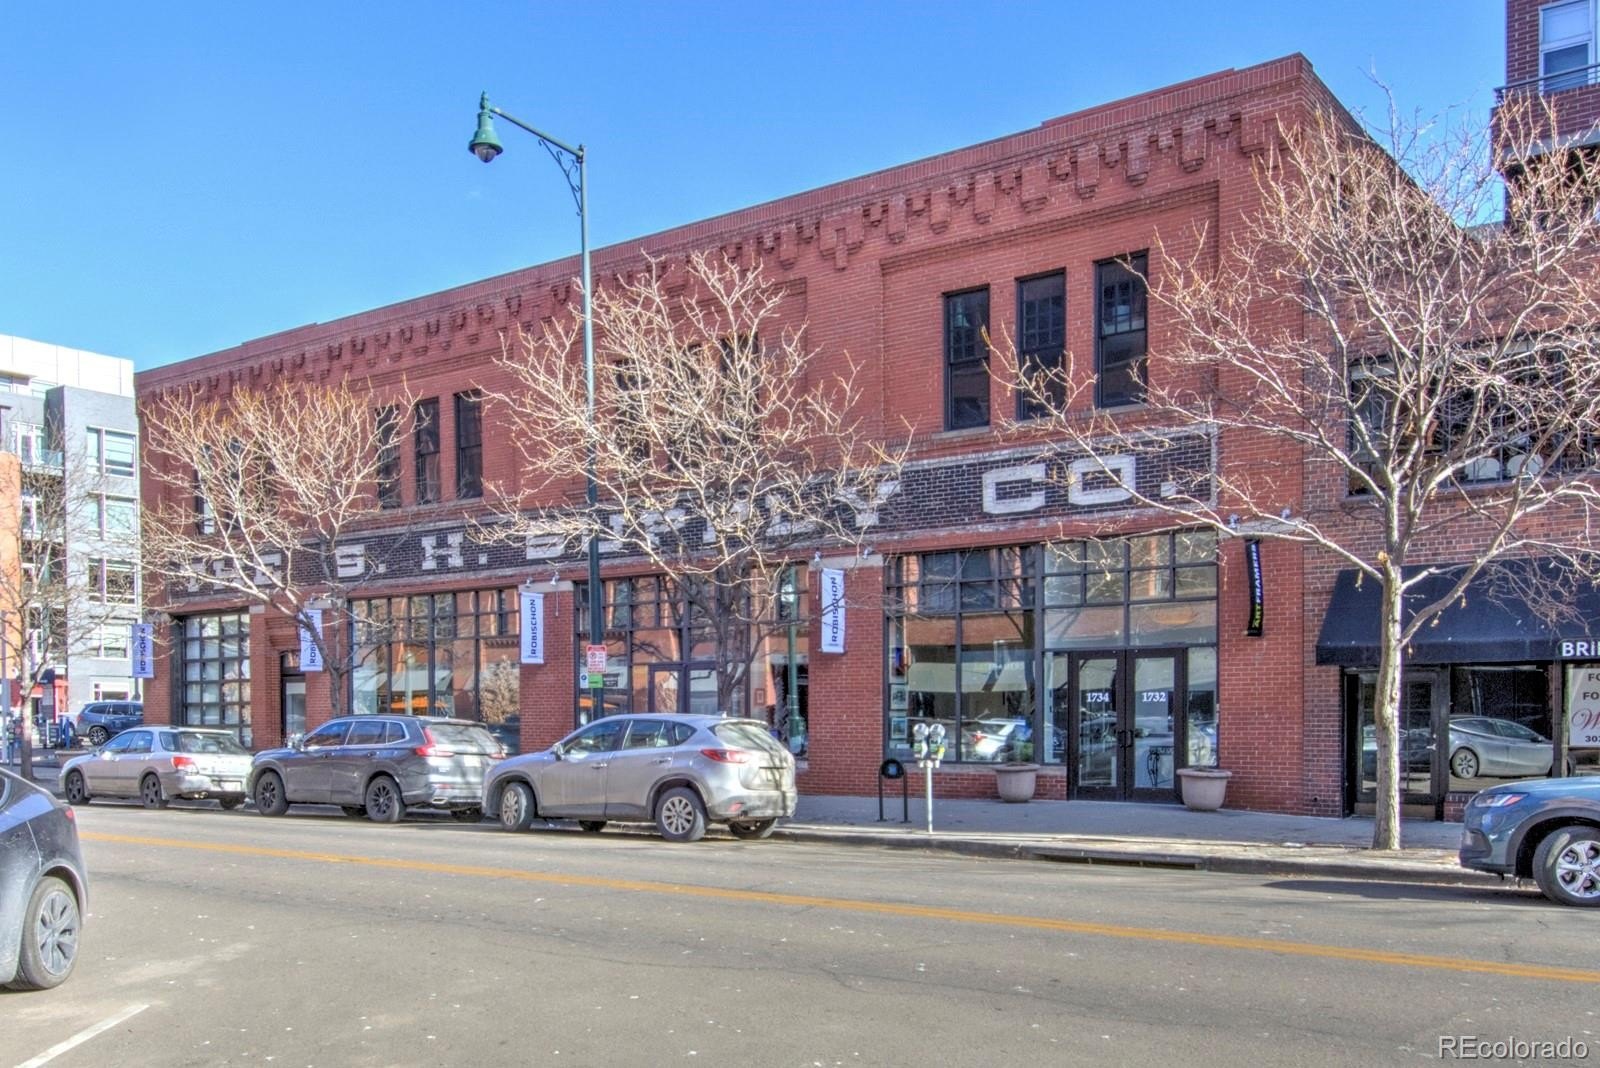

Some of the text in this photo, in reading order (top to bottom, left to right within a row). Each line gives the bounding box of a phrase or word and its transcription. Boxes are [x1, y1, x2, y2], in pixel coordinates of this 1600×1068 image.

[336, 544, 386, 578] S.
[421, 532, 488, 570] H.
[982, 454, 1177, 514] CO.
[529, 598, 538, 655] ROBISCHON
[830, 577, 839, 642] ROBISCHON
[1086, 692, 1110, 703] 1734
[1142, 692, 1167, 703] 1732
